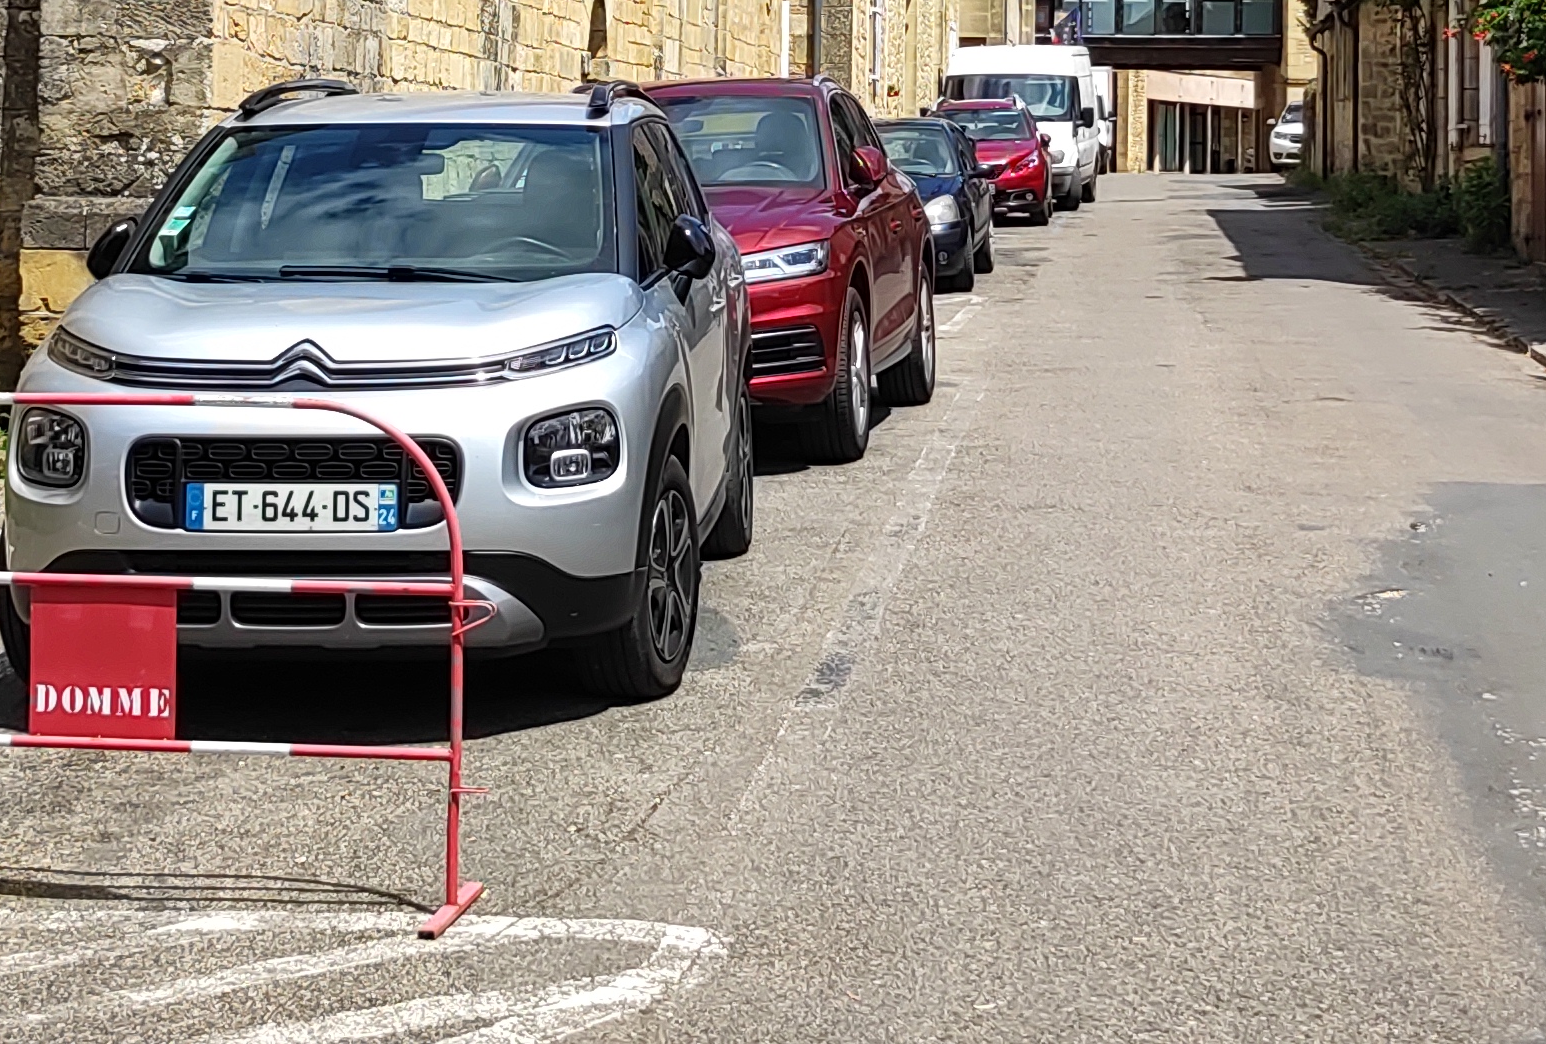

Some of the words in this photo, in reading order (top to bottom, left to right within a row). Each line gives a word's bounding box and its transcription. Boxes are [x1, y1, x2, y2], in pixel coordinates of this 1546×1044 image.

[191, 510, 199, 522] F
[378, 508, 396, 525] 24
[35, 683, 171, 718] DOMME
